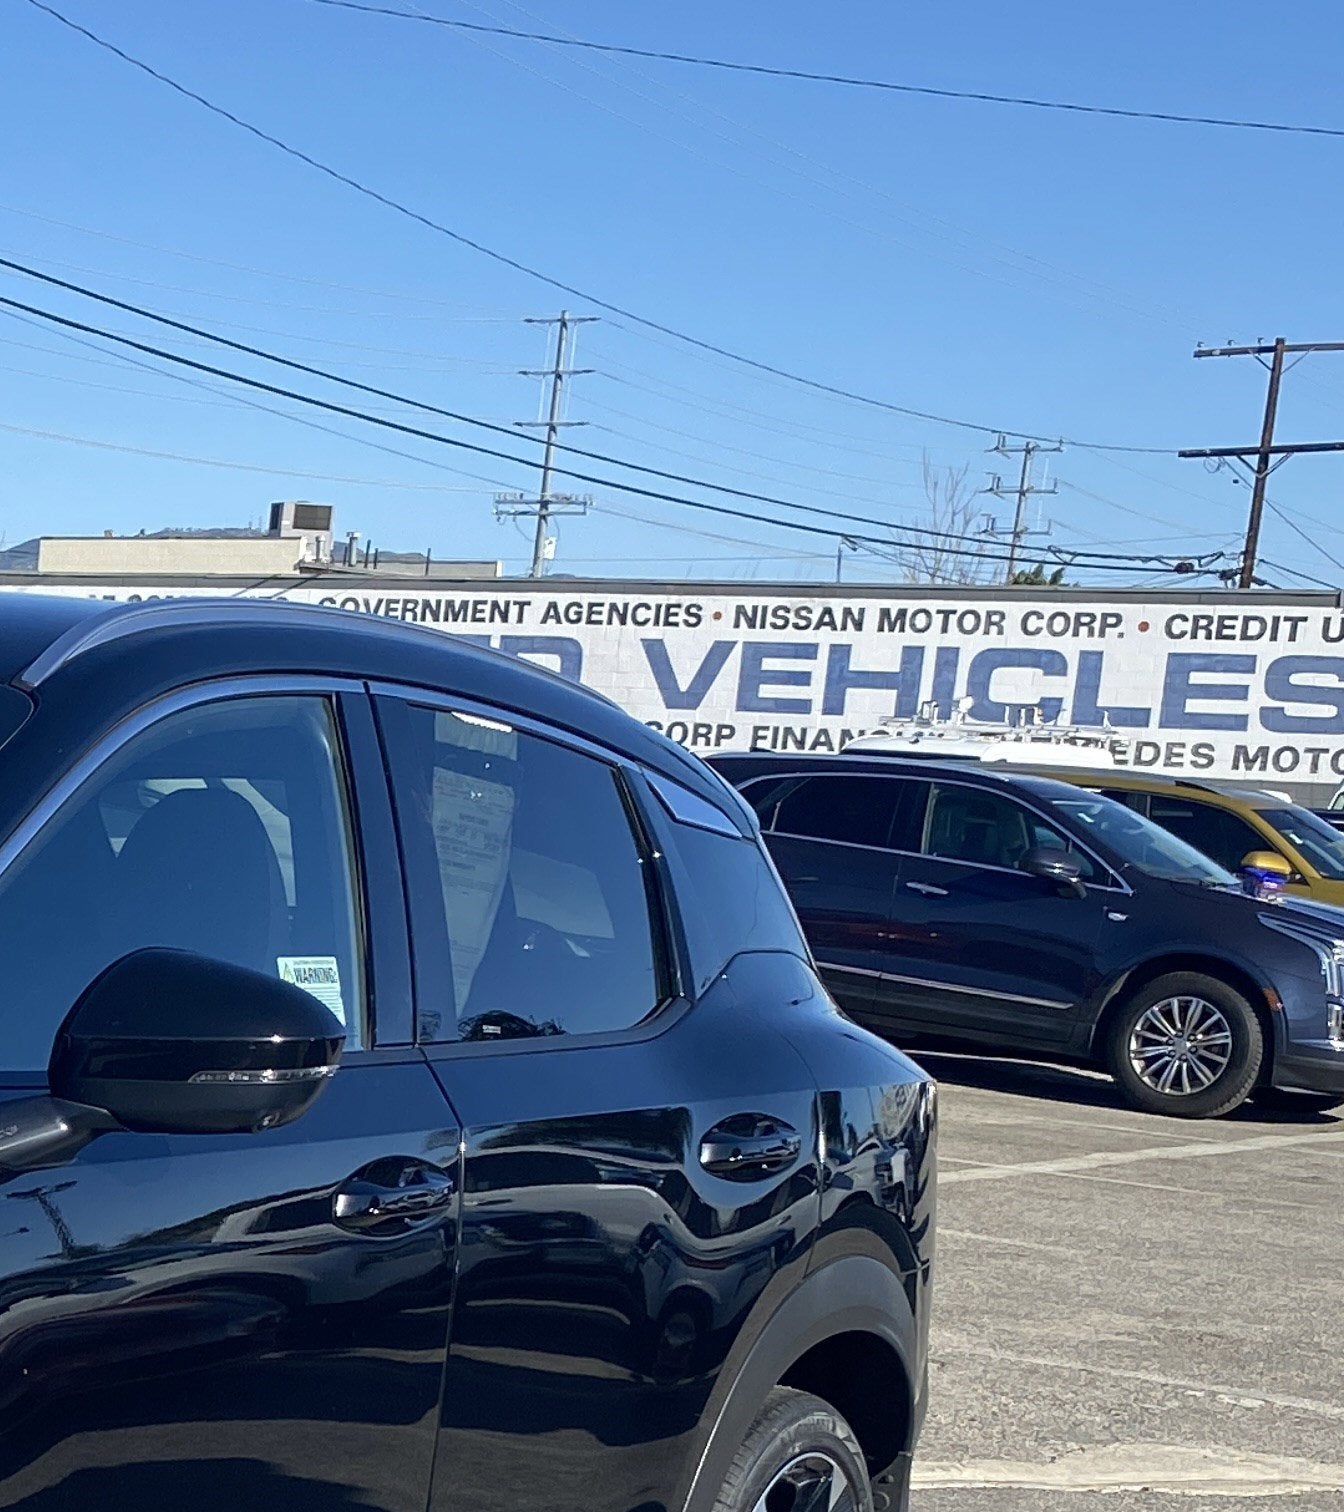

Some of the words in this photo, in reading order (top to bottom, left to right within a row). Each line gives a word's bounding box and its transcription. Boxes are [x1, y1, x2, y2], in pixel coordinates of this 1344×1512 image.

[540, 601, 703, 628] AGENCIES
[733, 604, 865, 632] NISSAN
[877, 607, 1005, 636] MOTOR
[1020, 610, 1125, 639] CORP.
[1164, 613, 1308, 642] CREDIT
[640, 637, 1344, 735] VEHICLES
